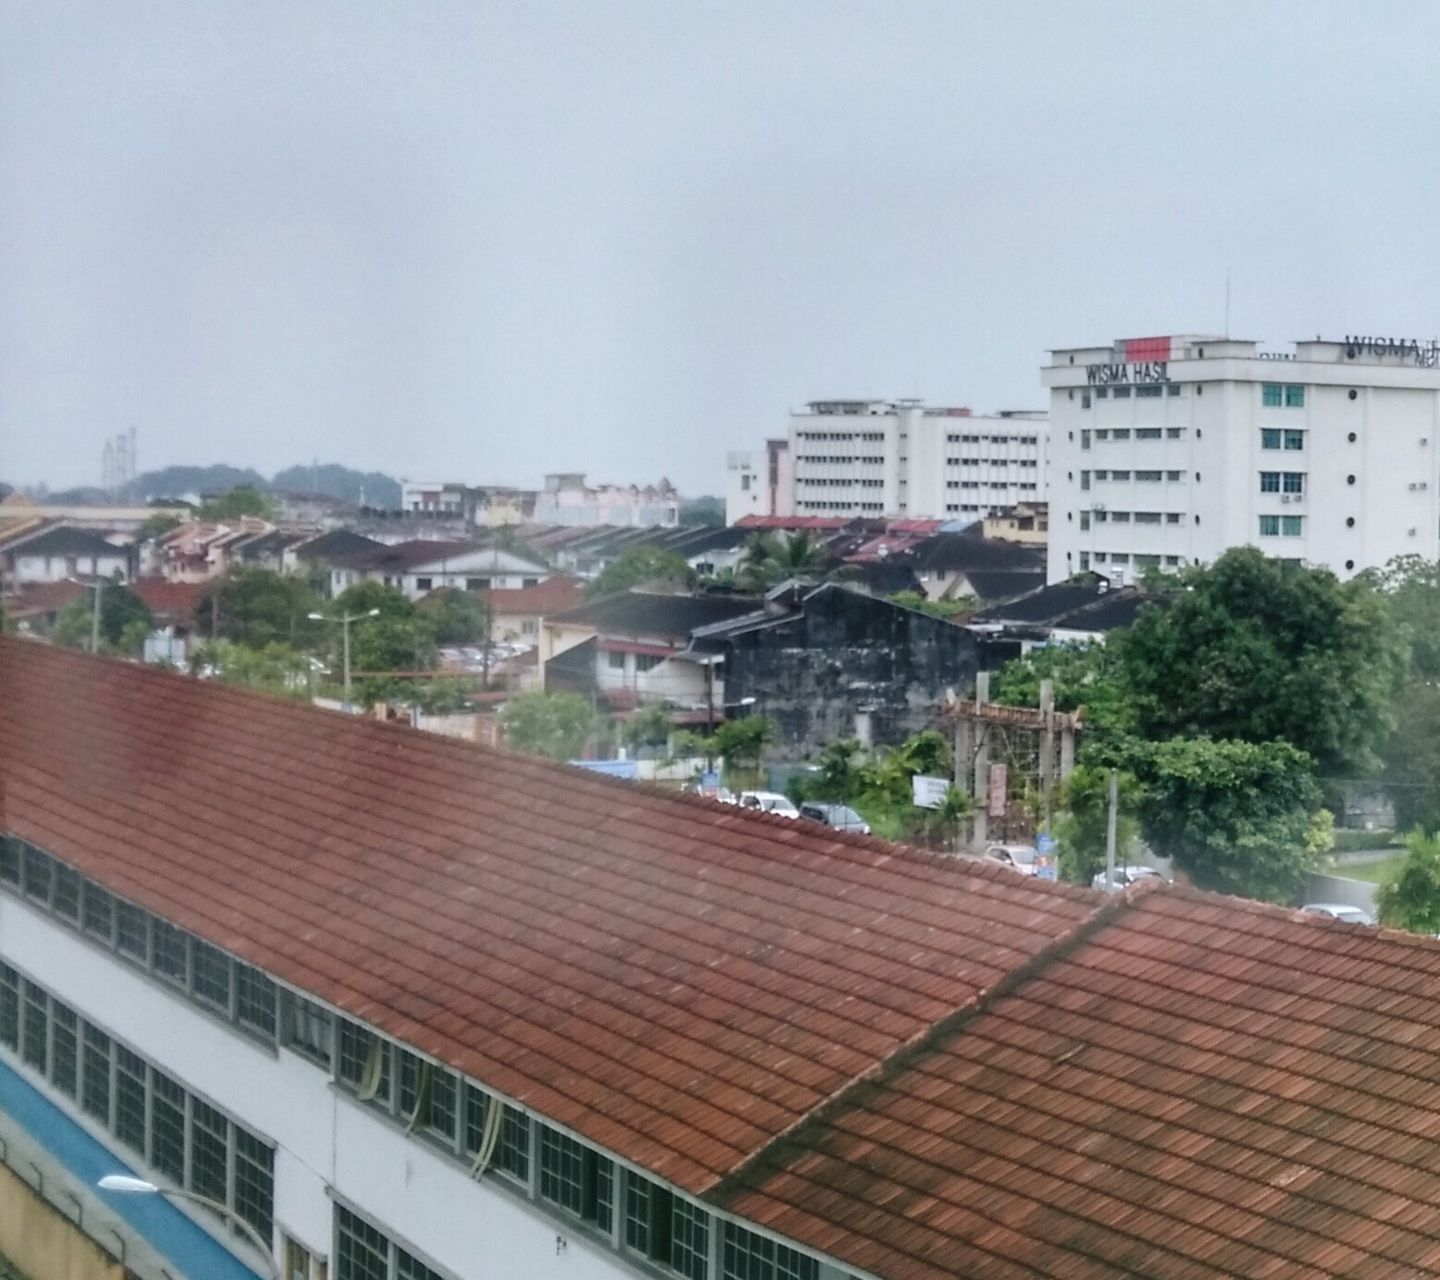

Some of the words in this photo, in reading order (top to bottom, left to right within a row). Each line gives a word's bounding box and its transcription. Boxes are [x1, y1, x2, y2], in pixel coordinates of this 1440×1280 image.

[1346, 335, 1420, 359] WISMA
[1086, 363, 1129, 385] WISMA
[1134, 361, 1171, 383] HASIL
